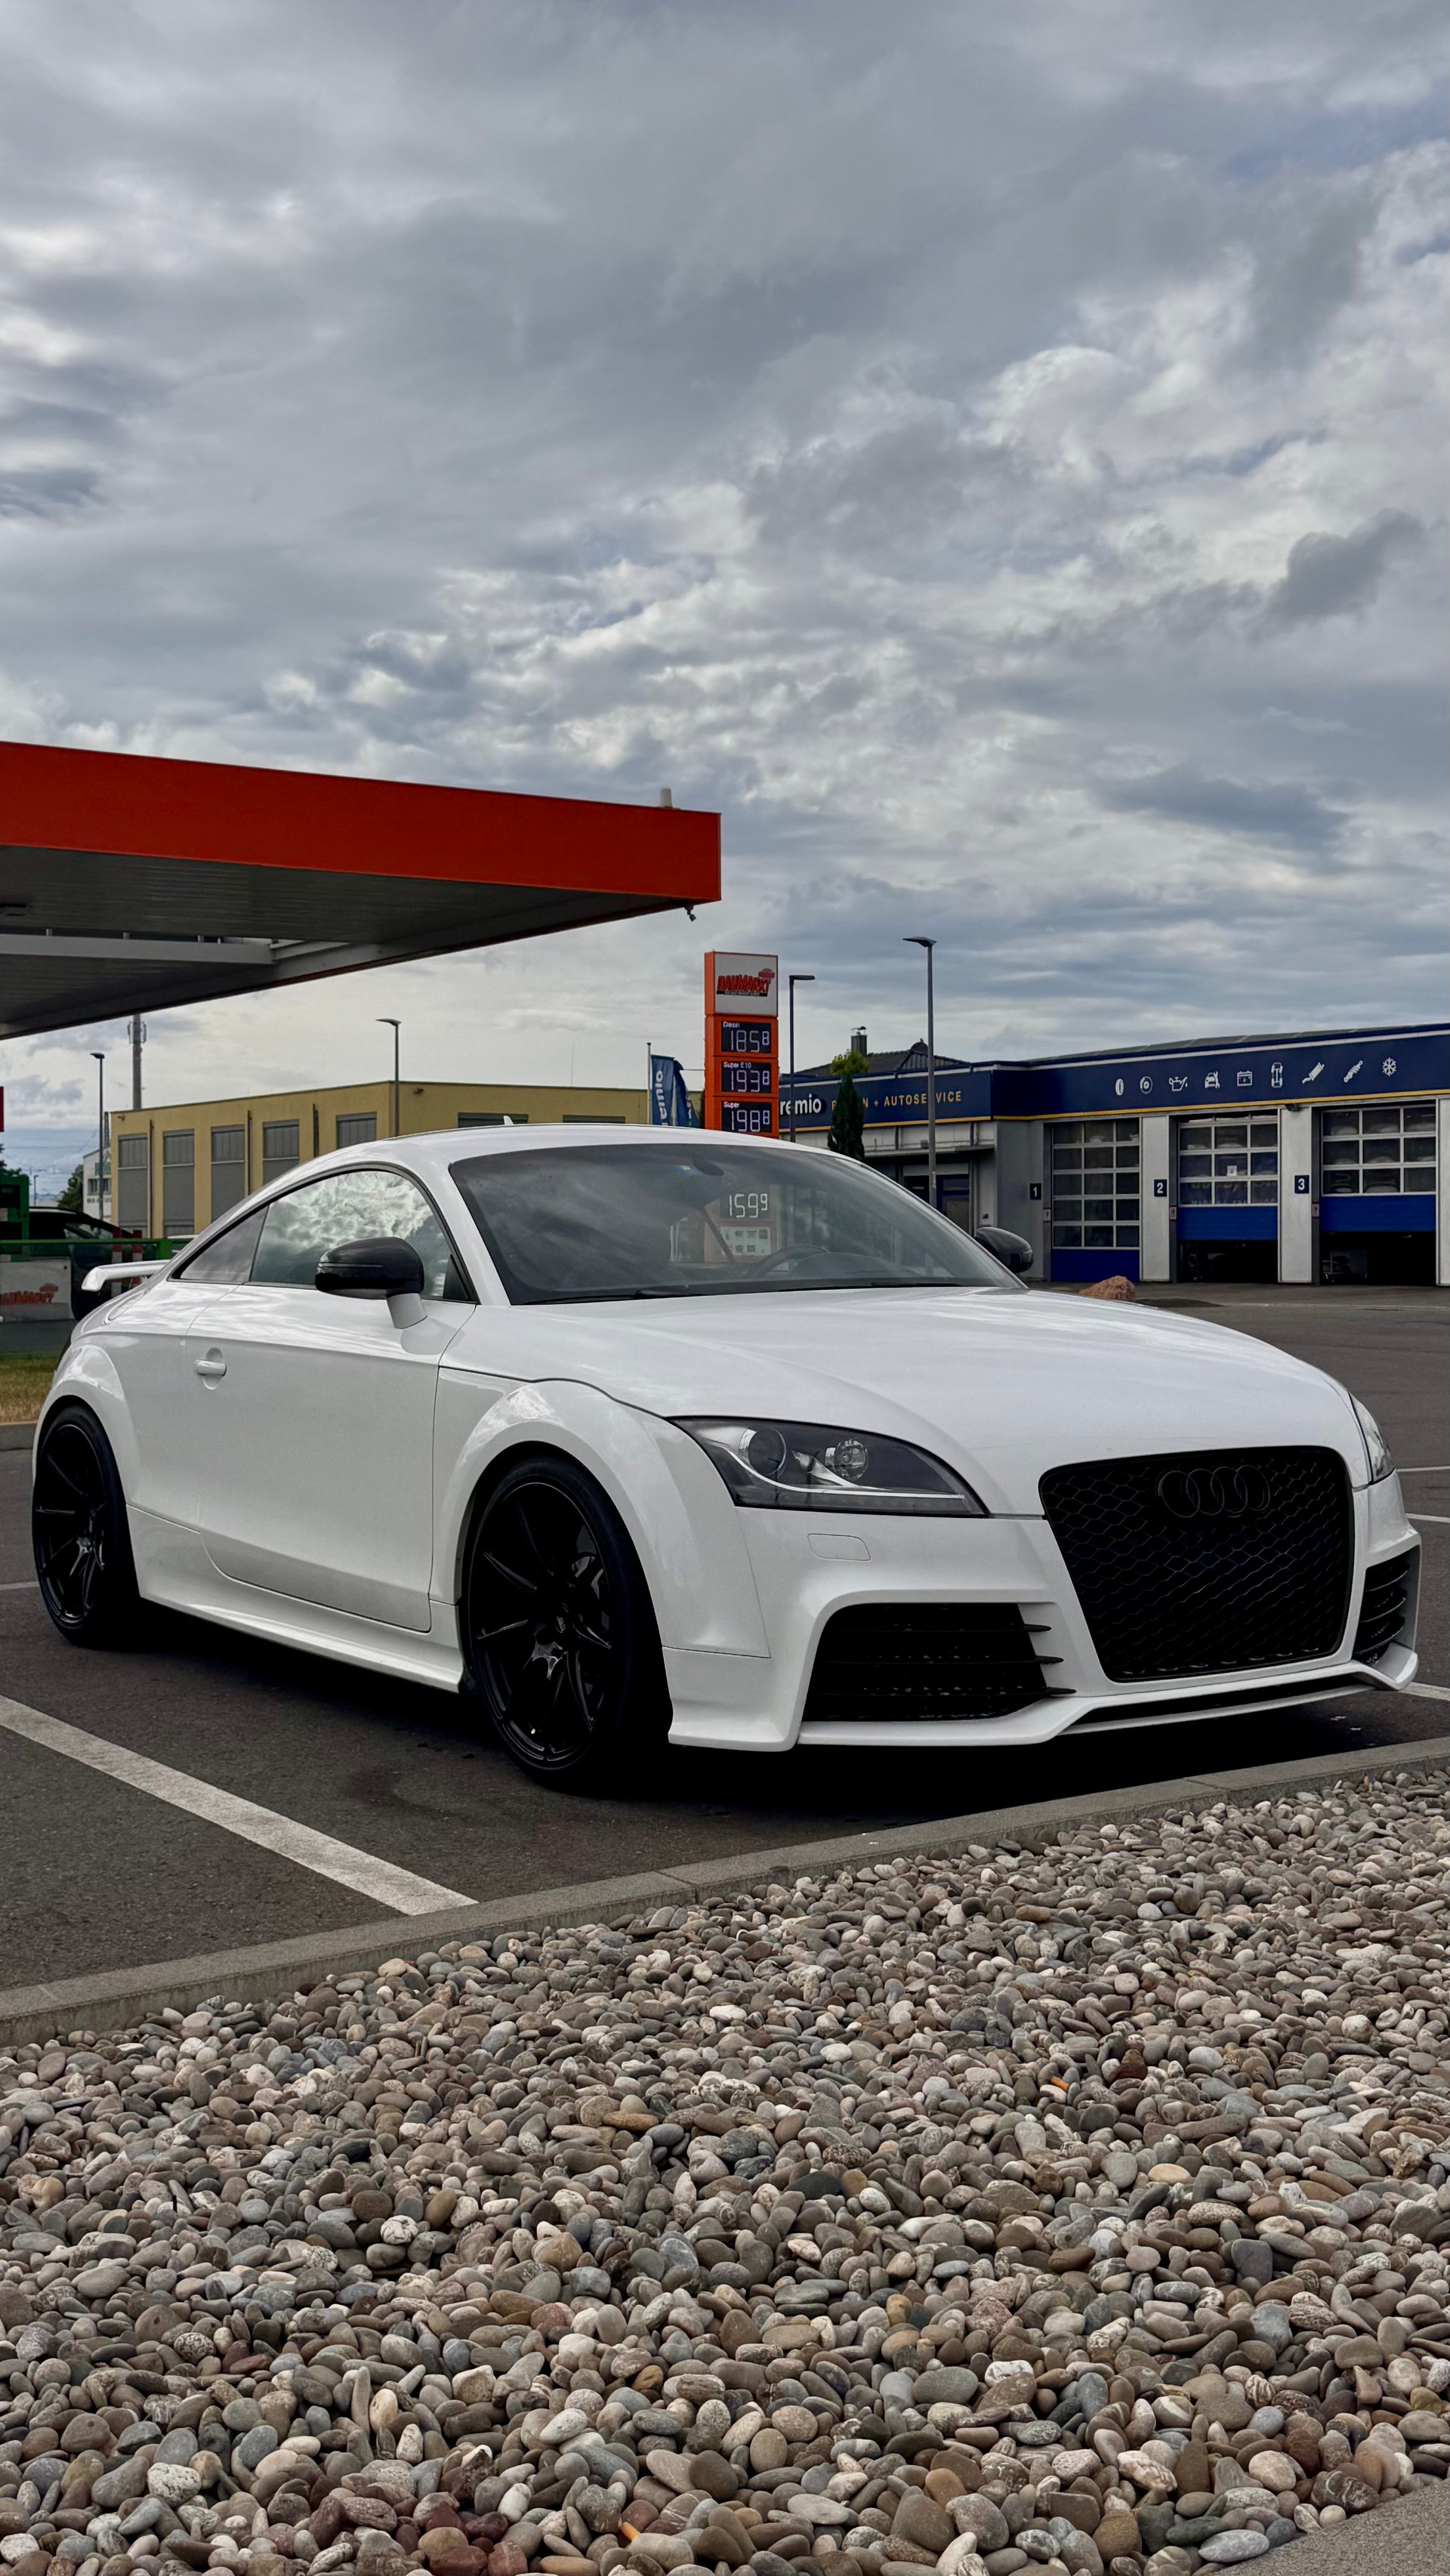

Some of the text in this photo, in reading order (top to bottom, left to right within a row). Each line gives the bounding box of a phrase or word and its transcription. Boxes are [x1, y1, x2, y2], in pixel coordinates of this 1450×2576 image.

[723, 1061, 739, 1069] Super
[779, 1093, 822, 1115] remio
[884, 1091, 961, 1107] AUTOSEVICE
[1156, 1182, 1164, 1194] 2
[1297, 1178, 1305, 1191] 3
